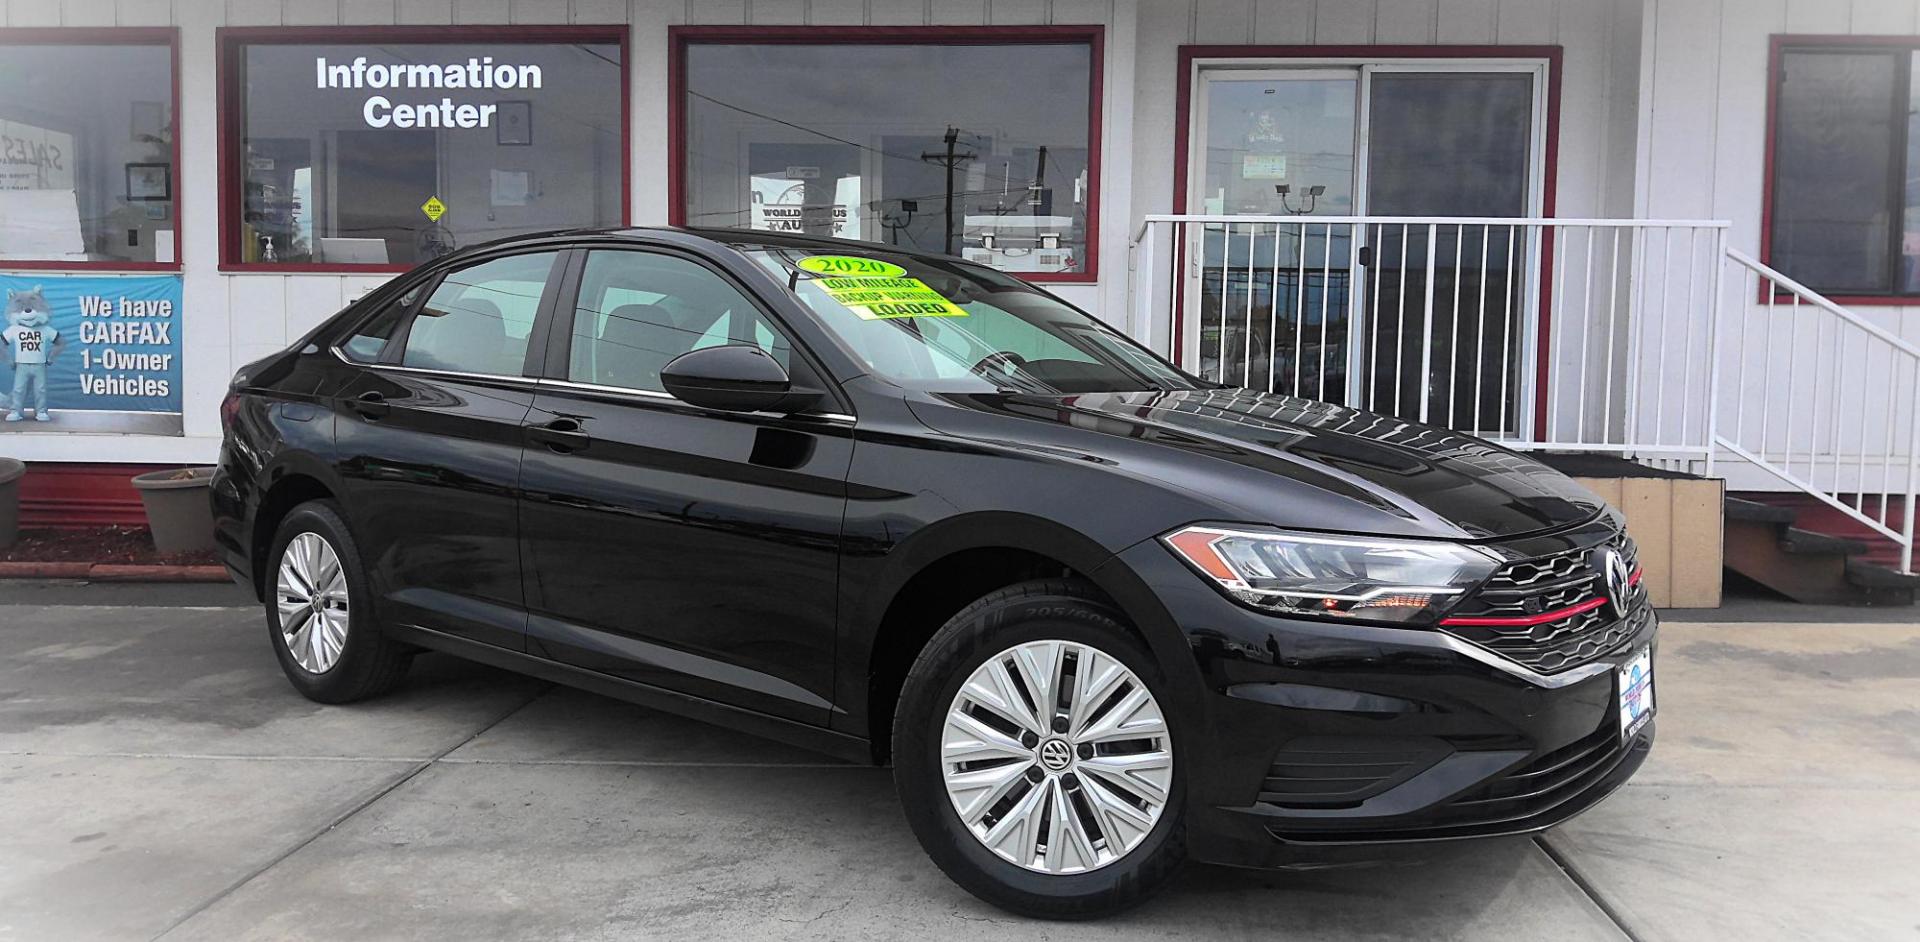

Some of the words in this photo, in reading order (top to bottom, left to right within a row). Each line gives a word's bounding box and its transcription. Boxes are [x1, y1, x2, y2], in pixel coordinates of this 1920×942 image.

[316, 57, 542, 89] Information
[363, 96, 497, 128] Center
[763, 208, 801, 217] WORLD
[816, 258, 886, 273] 2020
[821, 278, 857, 290] LOW
[858, 278, 920, 289] MILEAGE
[79, 295, 112, 318] We
[119, 296, 172, 318] have
[868, 303, 949, 317] LOADED
[18, 331, 42, 341] CAR
[79, 321, 171, 345] CARFAX
[20, 341, 41, 352] FOX
[80, 348, 172, 372] 1-Owner
[79, 374, 169, 397] Vehicles
